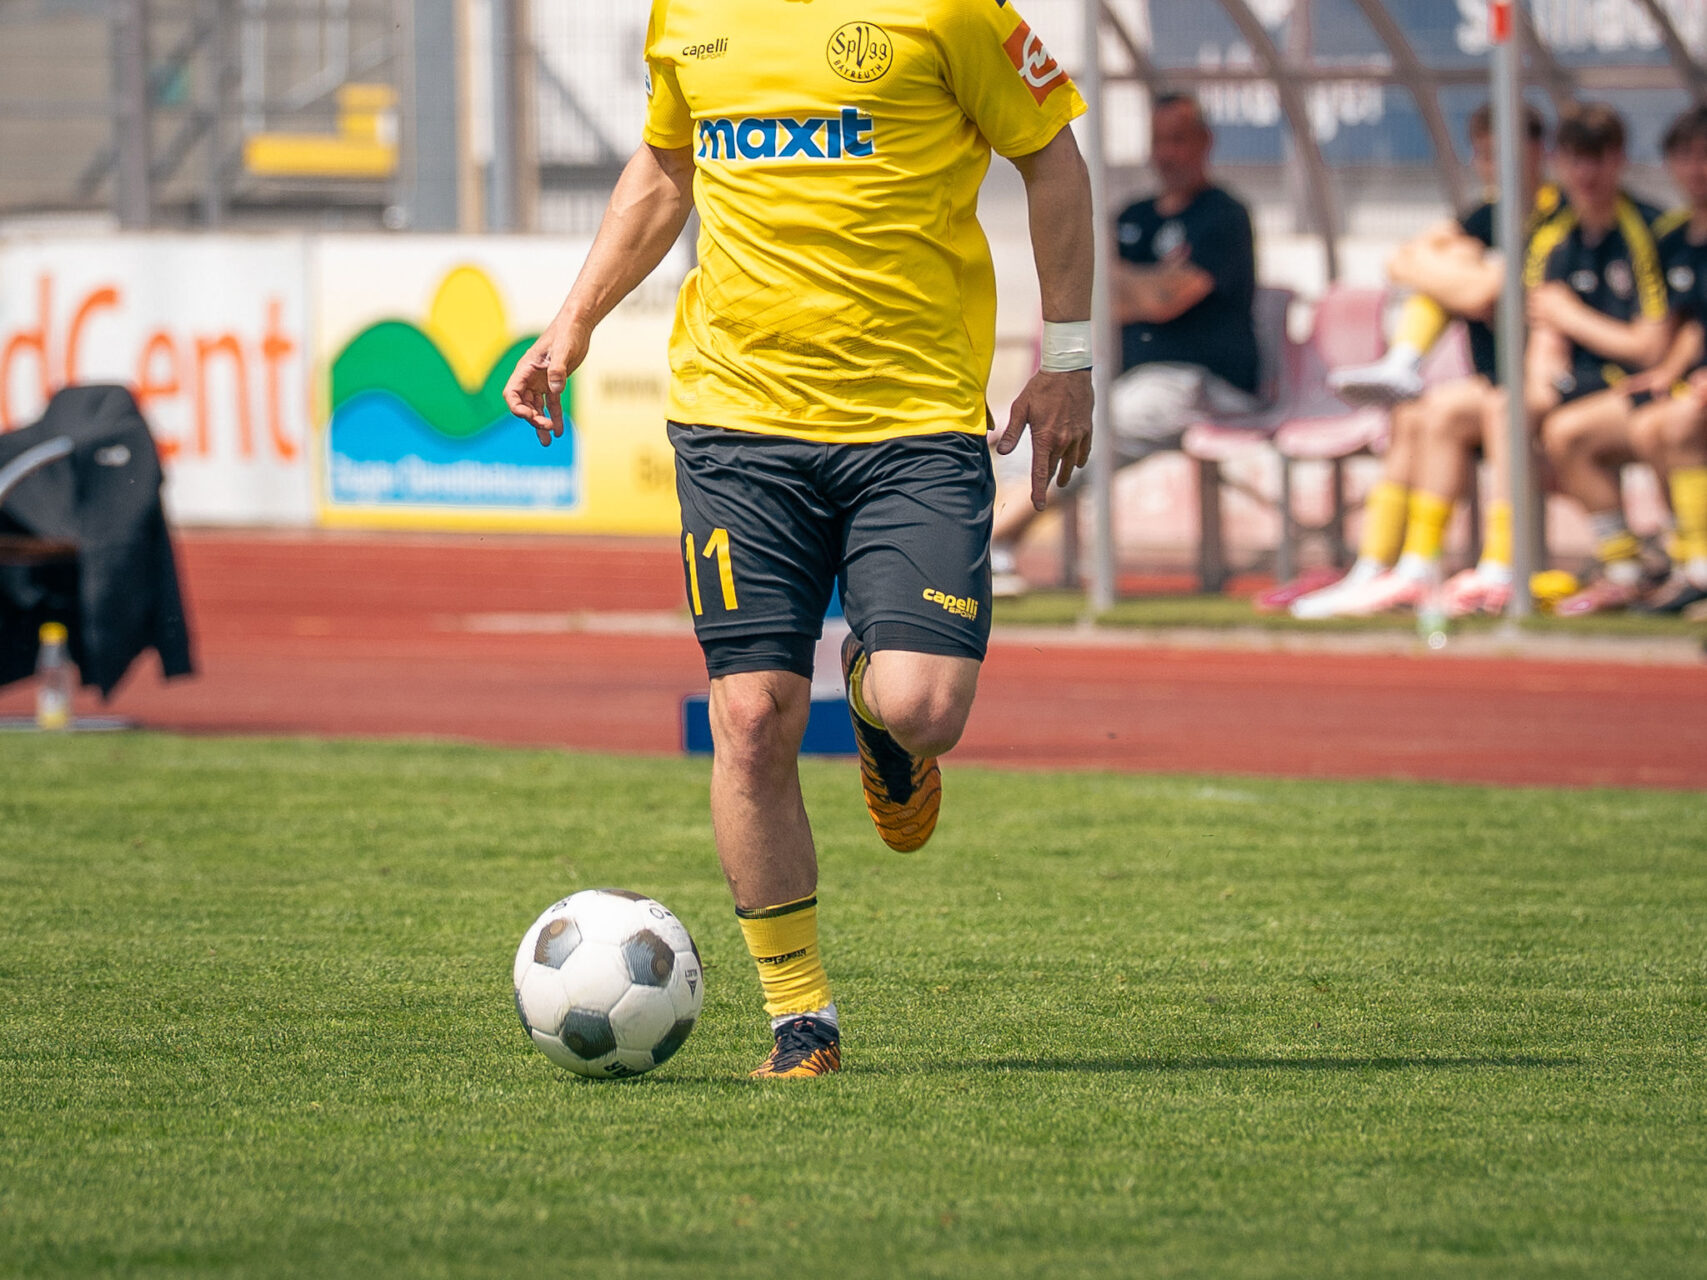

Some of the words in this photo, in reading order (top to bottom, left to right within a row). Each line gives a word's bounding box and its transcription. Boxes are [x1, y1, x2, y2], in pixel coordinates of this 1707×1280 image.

[682, 38, 728, 59] capelli
[833, 59, 884, 80] BAYREUTH
[697, 107, 873, 161] maxit
[685, 527, 739, 616] 11
[922, 587, 979, 618] capelli
